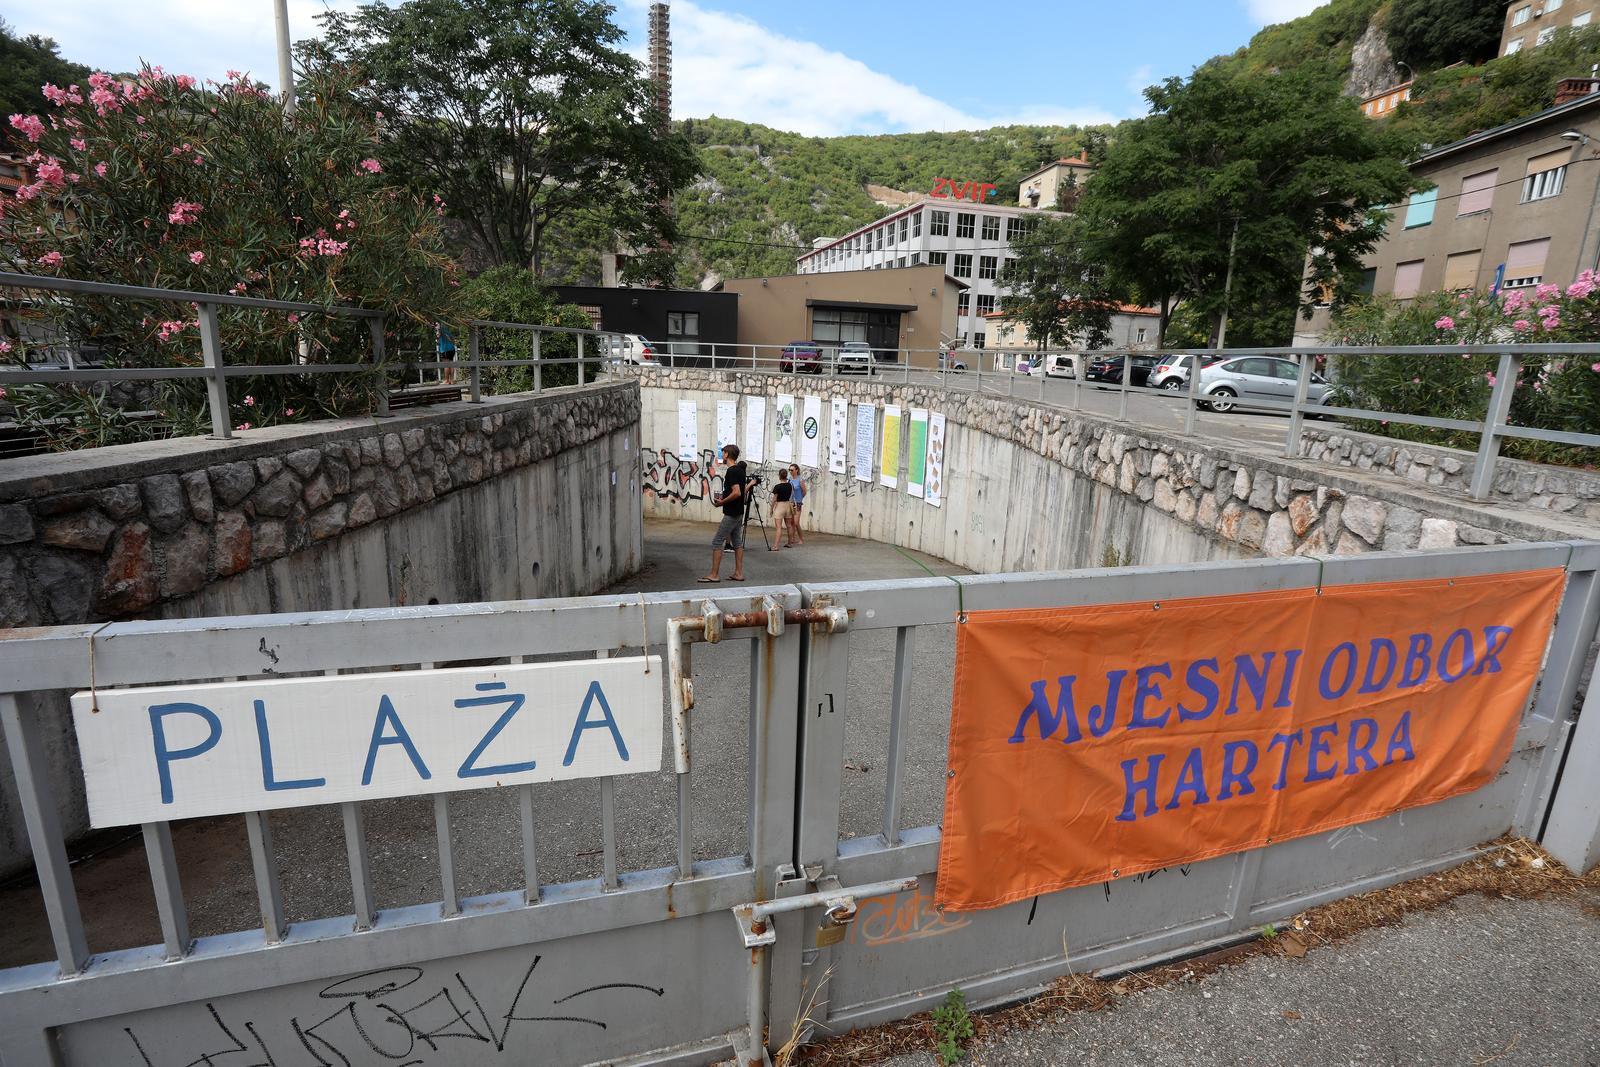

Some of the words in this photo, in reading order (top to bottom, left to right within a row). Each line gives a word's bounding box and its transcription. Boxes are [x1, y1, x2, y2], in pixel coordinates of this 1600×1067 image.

[148, 681, 630, 805] PLAŽA
[1008, 650, 1302, 744] MJESNI
[1319, 625, 1513, 700] ODBOR
[1114, 709, 1416, 822] HARTERA
